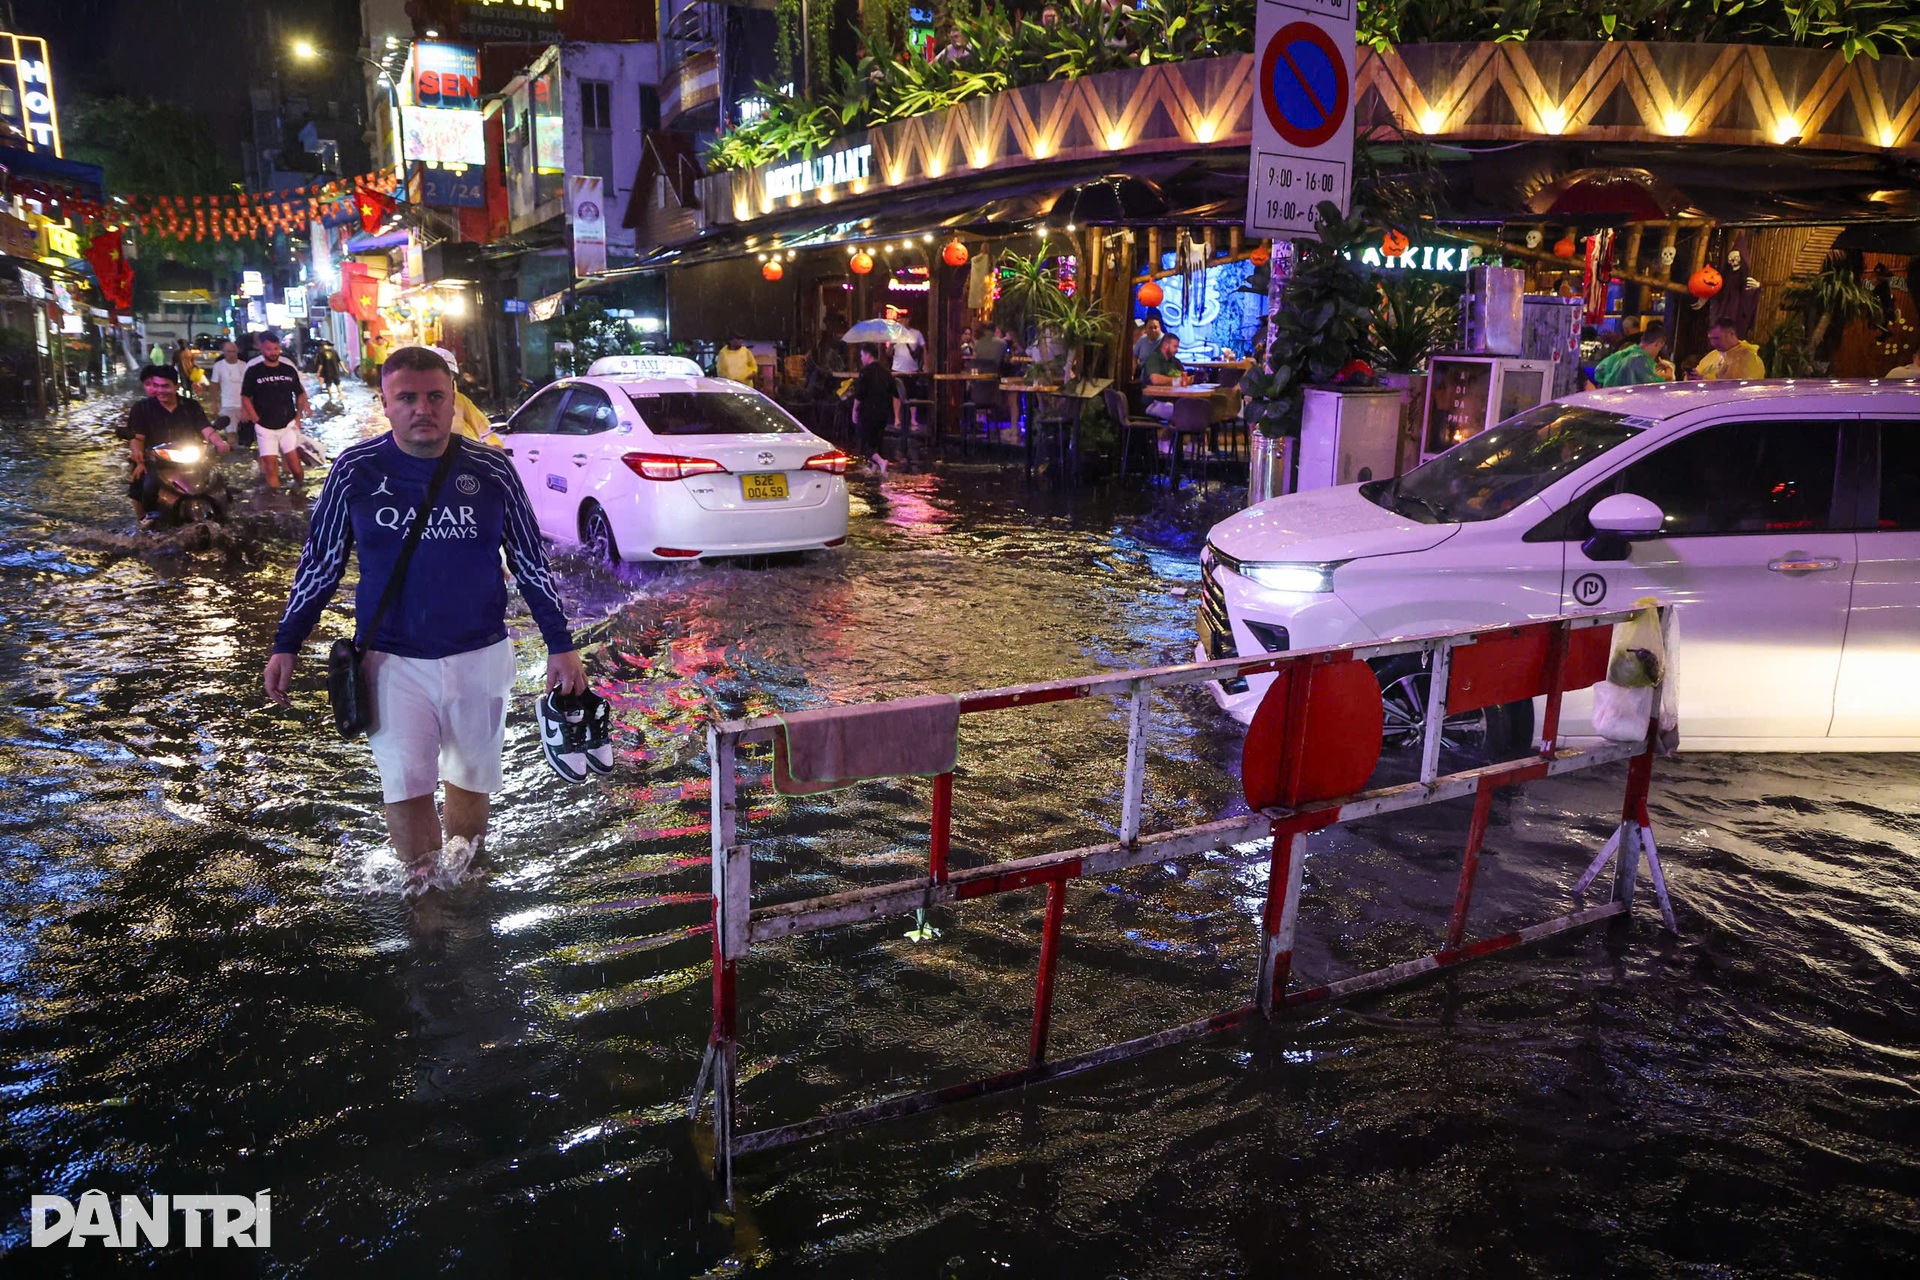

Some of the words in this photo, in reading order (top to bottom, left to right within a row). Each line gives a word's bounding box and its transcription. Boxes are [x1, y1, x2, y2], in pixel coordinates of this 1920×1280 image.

[470, 5, 553, 24] RESTAURANT
[459, 22, 521, 38] SEAFOOD
[419, 70, 480, 99] SEN
[765, 144, 871, 198] RESTAURANT
[1268, 167, 1292, 187] 9:00
[1306, 171, 1333, 192] 16:00
[1266, 200, 1296, 220] 19:00
[1332, 246, 1469, 272] AIKIKI
[633, 360, 659, 370] TAXI
[754, 475, 774, 486] 62E
[748, 486, 783, 498] 004.59
[375, 506, 477, 531] QATAR
[402, 526, 477, 540] ARWAYS
